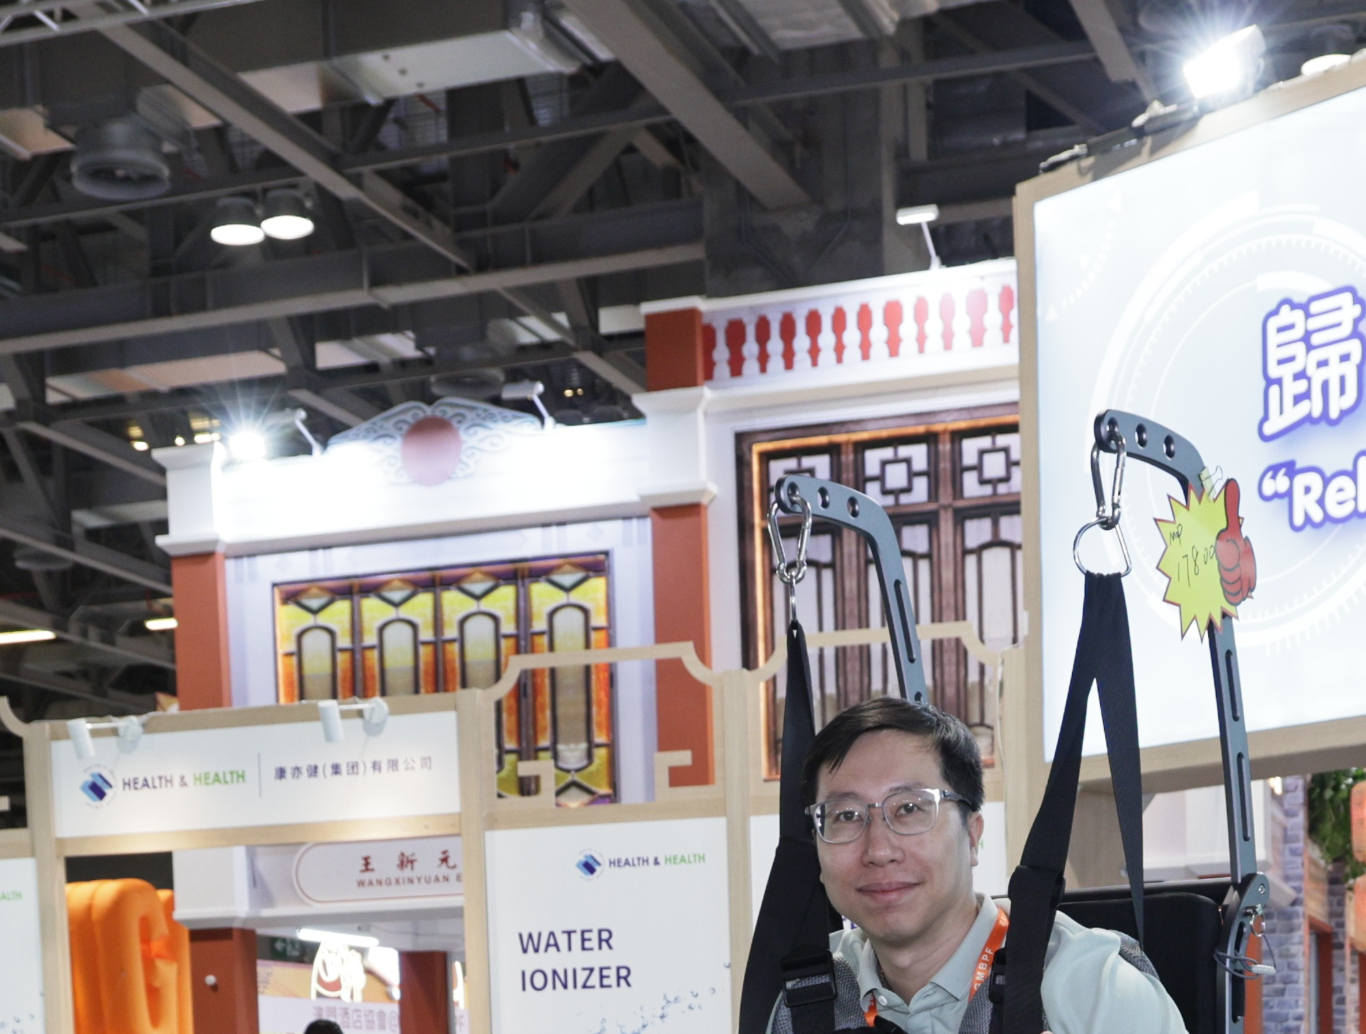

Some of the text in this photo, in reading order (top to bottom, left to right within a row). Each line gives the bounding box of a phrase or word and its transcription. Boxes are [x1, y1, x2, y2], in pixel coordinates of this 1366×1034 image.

[274, 755, 433, 781] 康亦健(集团)有限公司
[122, 770, 246, 791] HEALTH & HEALTH
[608, 853, 706, 868] HEALTH & HEALTH
[356, 875, 450, 888] WANGXINYUAN
[518, 927, 615, 955] WATER
[520, 965, 632, 992] IONIZER
